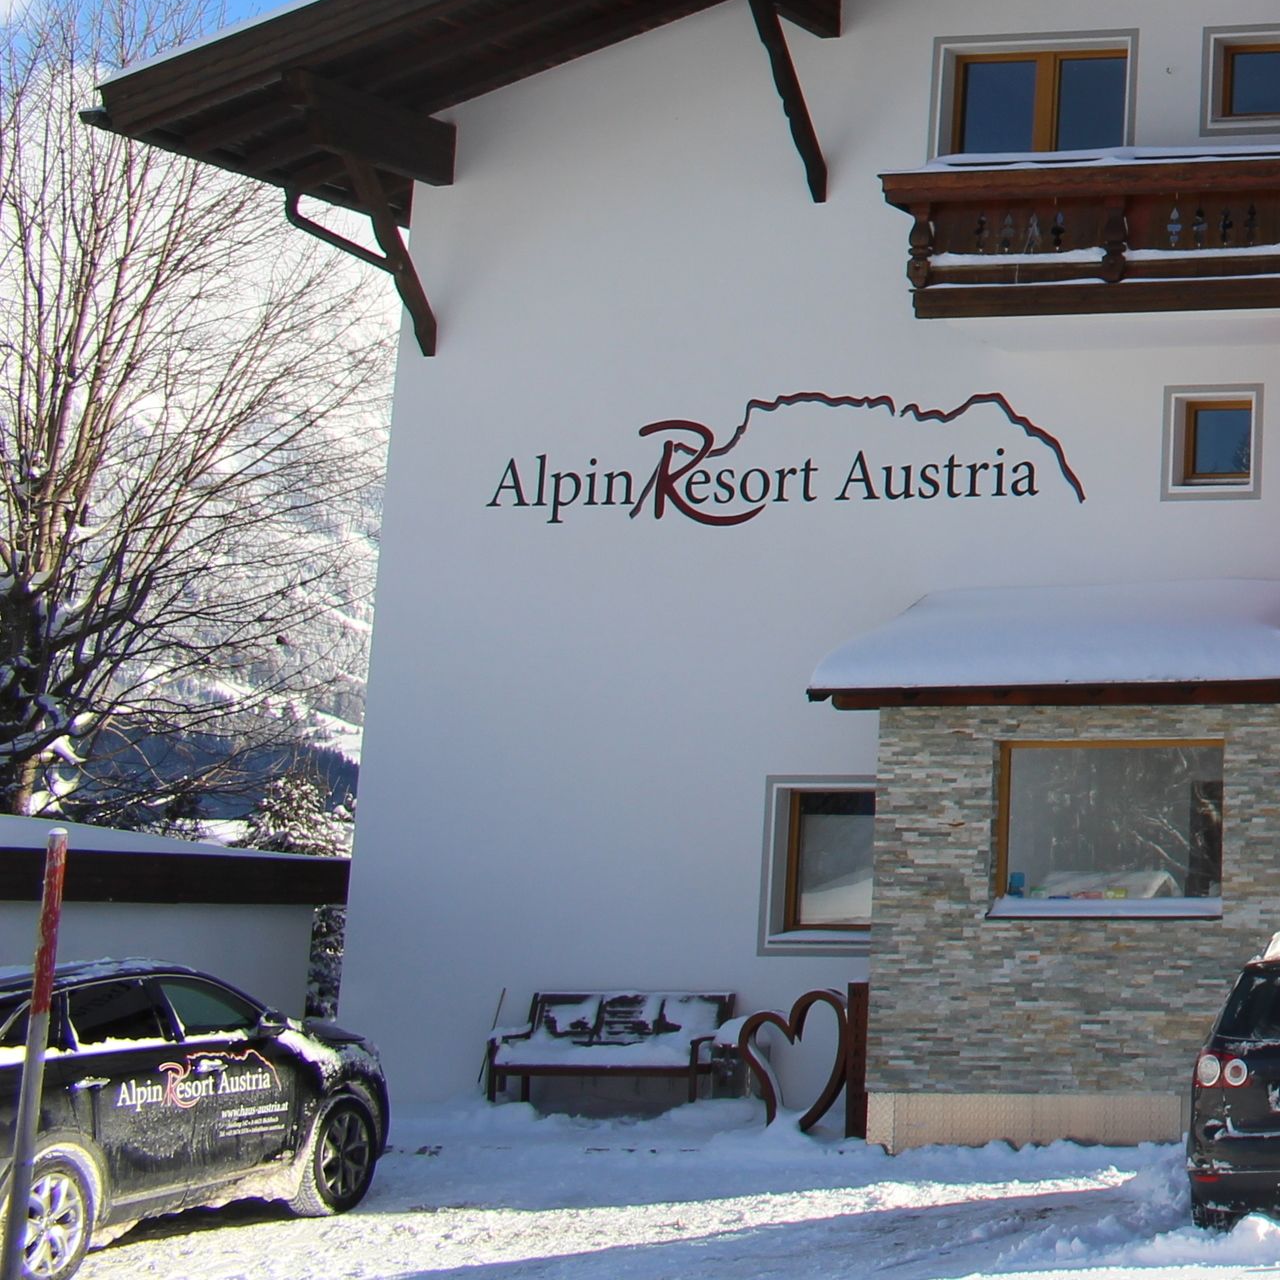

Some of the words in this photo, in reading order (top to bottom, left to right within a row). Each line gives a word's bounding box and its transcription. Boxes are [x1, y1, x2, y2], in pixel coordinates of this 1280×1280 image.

[485, 454, 634, 524] Alpin
[834, 446, 1040, 502] Austria
[117, 1079, 162, 1111] Alpin
[218, 1068, 271, 1095] Austria
